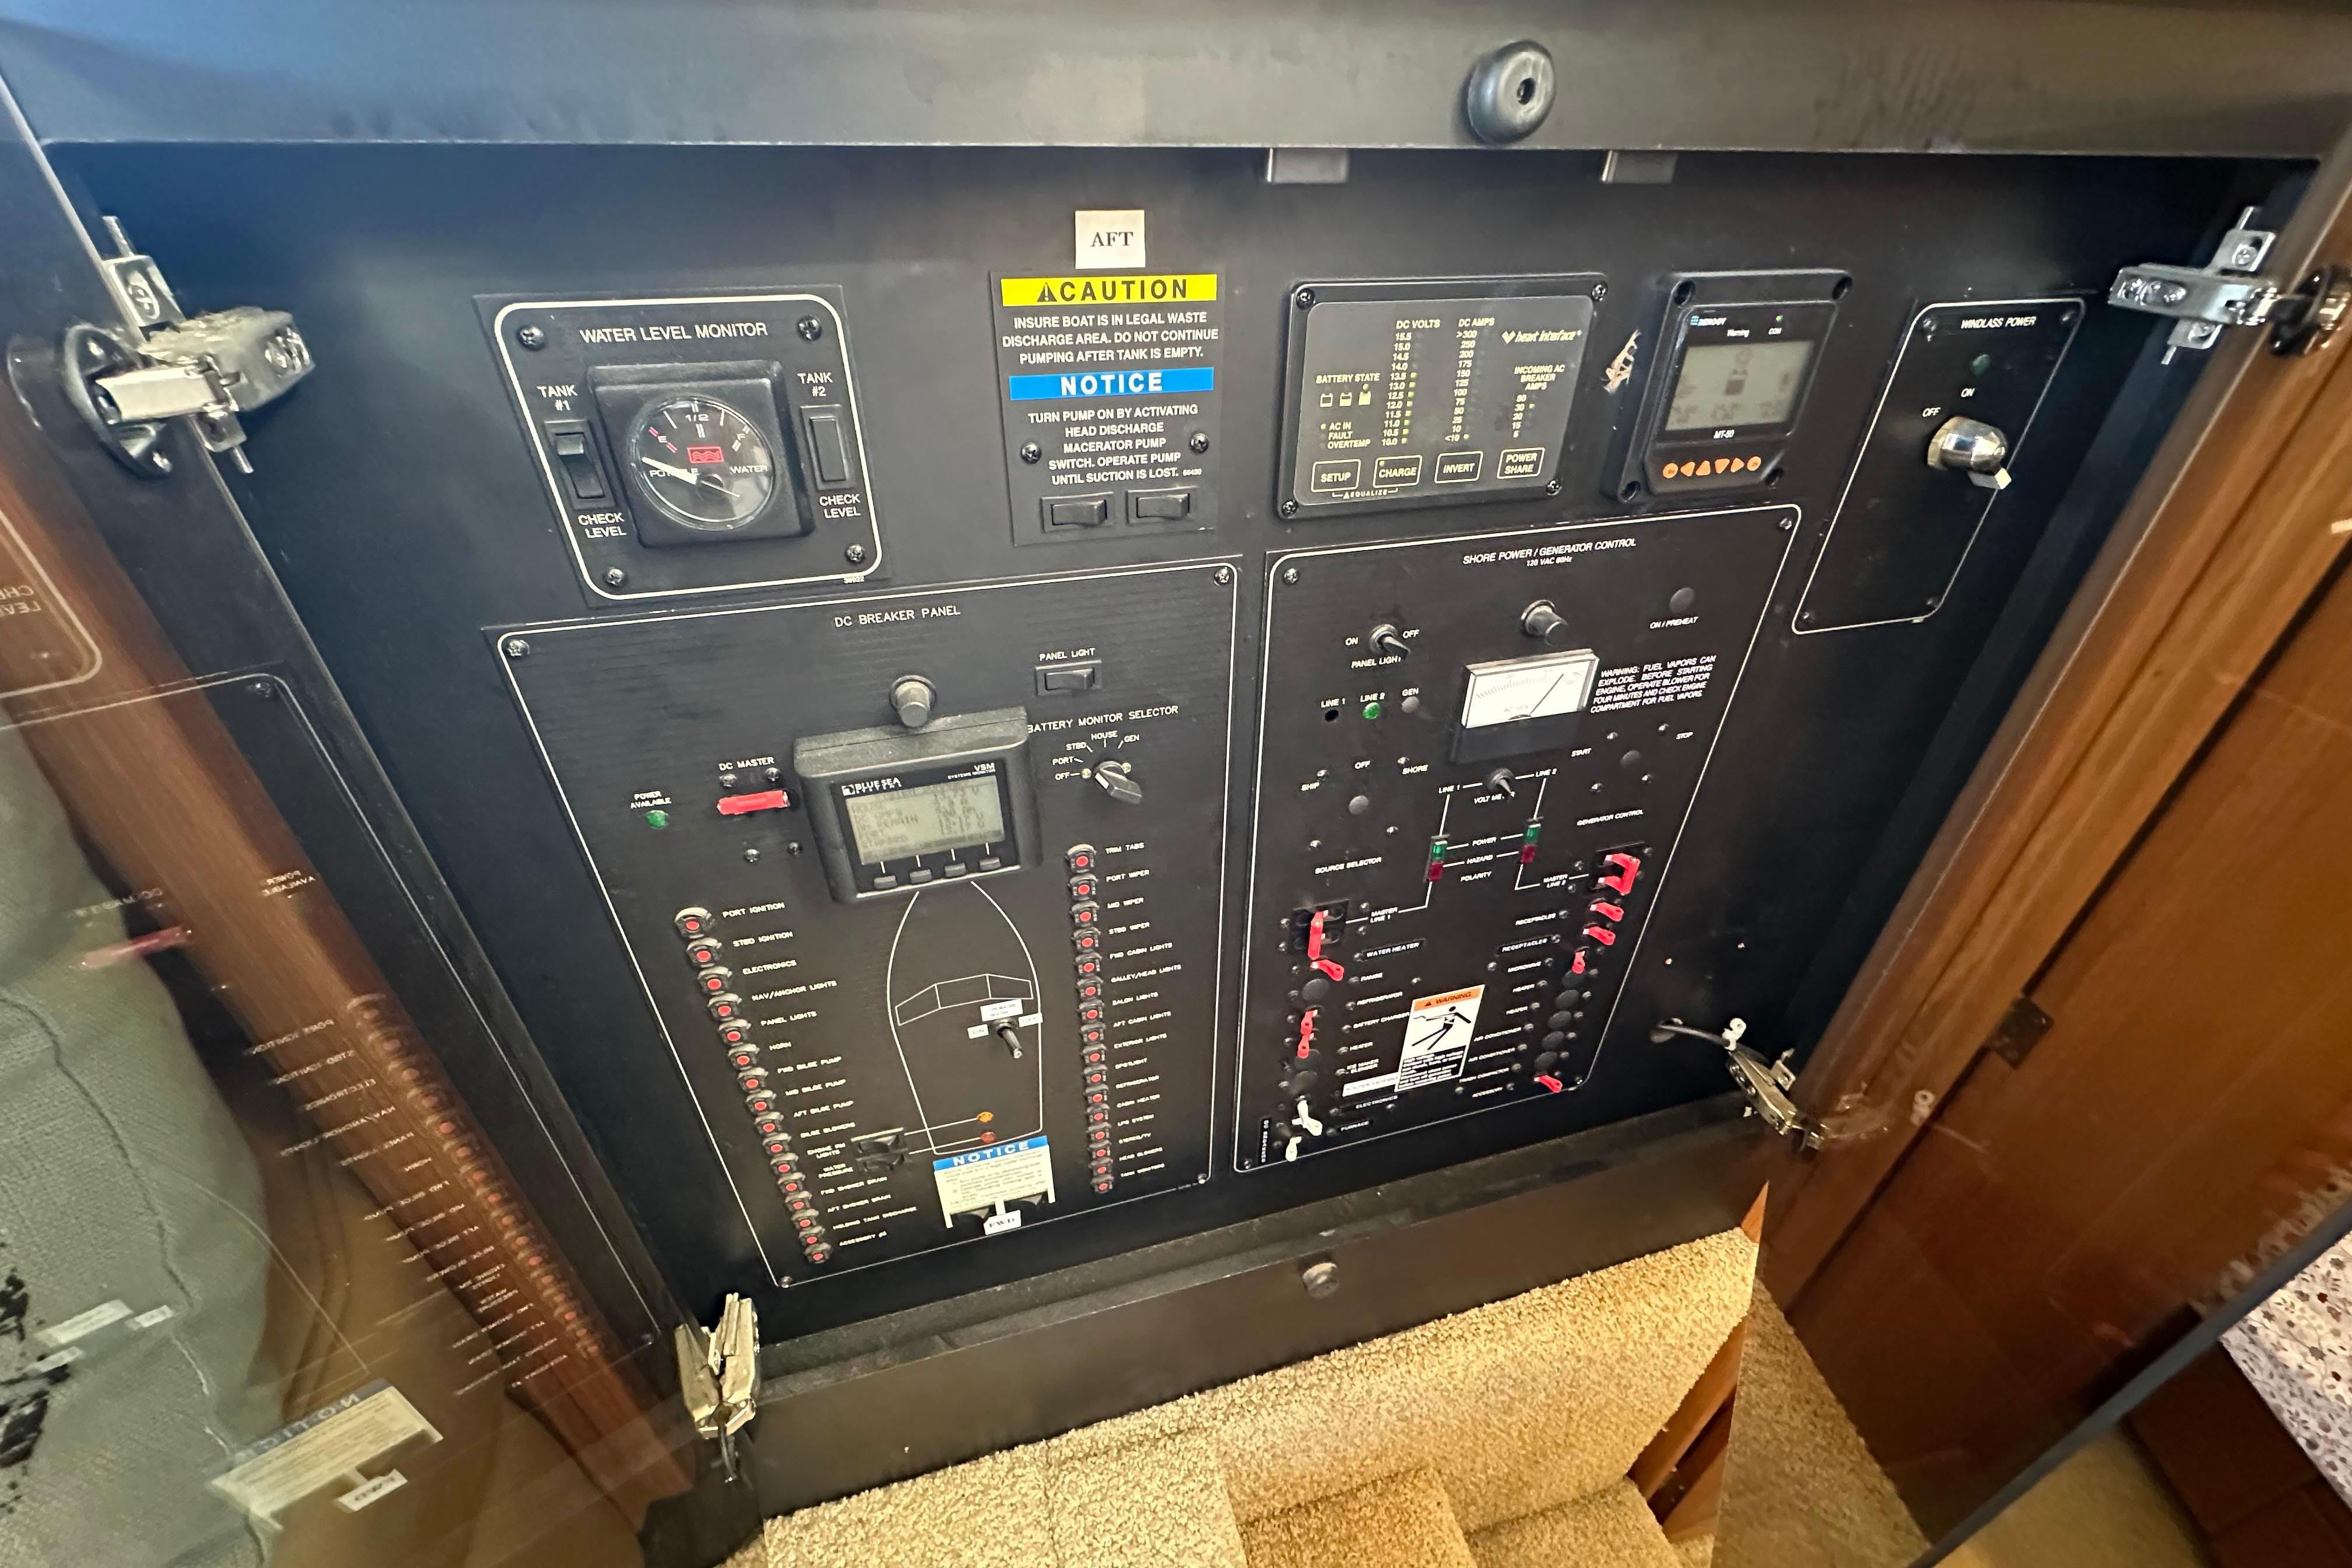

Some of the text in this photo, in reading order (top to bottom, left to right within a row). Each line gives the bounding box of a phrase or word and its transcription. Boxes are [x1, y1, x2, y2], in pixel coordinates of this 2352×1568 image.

[1091, 232, 1133, 247] AFT
[1060, 279, 1186, 302] CAUTION
[1014, 312, 1207, 329] INSURE BOAT IS IN LEGAL WASTE
[1396, 319, 1440, 329] DC VOLTS
[1458, 317, 1495, 327] DC AMPS
[1961, 316, 2036, 329] WINDLASS POWER
[579, 323, 768, 343] WATER LEVEL MONITOR
[1002, 328, 1219, 347] DISCHARGE AREA. DO NOT CONTINUE
[1395, 332, 1412, 341] 15.5
[1514, 330, 1576, 342] heart interface
[1394, 342, 1410, 351] 15.0
[1020, 346, 1203, 365] PUMPING AFTER TANK IS EMPTY.
[1392, 352, 1409, 360] 14.5
[1391, 362, 1408, 371] 14.0
[1514, 364, 1565, 374] INCOMING AC
[797, 372, 833, 384] TANK
[1316, 373, 1380, 384] BATTERY STATE
[1390, 372, 1406, 380] 13.5
[1520, 373, 1556, 383] BREAKER
[1061, 372, 1162, 396] NOTICE
[1389, 382, 1405, 390] 13.0
[1525, 382, 1547, 390] AMPS
[537, 384, 578, 398] TANK
[812, 386, 827, 397] #2
[1388, 391, 1404, 400] 12.5
[1961, 388, 1975, 397] ON
[555, 400, 570, 411] #1
[1387, 401, 1403, 409] 12.0
[1028, 404, 1198, 424] TURN PUMP ON BY ACTIVATING
[1385, 410, 1401, 418] 11.5
[1922, 407, 1941, 417] OFF
[1329, 421, 1352, 430] AC IN
[1384, 419, 1400, 428] 11.0
[1065, 422, 1164, 438] HEAD DISCHARGE
[1383, 429, 1399, 437] 10.5
[737, 433, 746, 442] F
[1328, 431, 1353, 440] FAULT
[1063, 438, 1166, 453] MACERATOR PUMP
[1328, 439, 1371, 449] OVERTEMP
[1381, 438, 1398, 446] 10.0
[1049, 452, 1181, 470] SWITCH. OPERATE PUMP
[1506, 453, 1537, 463] POWER
[730, 463, 768, 474] WATER
[1379, 467, 1417, 478] CHARGE
[1443, 463, 1475, 473] INVERT
[1504, 464, 1534, 474] SHARE
[1052, 467, 1179, 485] UNTIL SUCTION IS LOST.
[1321, 472, 1351, 482] SETUP
[820, 494, 860, 506] CHECK
[824, 506, 861, 519] LEVEL
[578, 512, 625, 525] CHECK
[584, 526, 627, 538] LEVEL
[1462, 553, 1496, 564] SHORE
[1498, 549, 1532, 561] POWER
[1539, 542, 1593, 556] GENERATOR
[1594, 538, 1636, 550] CONTROL
[835, 606, 961, 627] DC BREAKER PANEL
[1402, 629, 1420, 638] OFF
[1345, 637, 1358, 646] ON
[1040, 648, 1095, 661] PANEL LIGHT
[1351, 659, 1377, 668] PANEL
[1601, 655, 1716, 678] WARNING: FUEL VAPORS CAN
[1402, 688, 1419, 696] GEN
[1360, 693, 1378, 702] LINE
[1321, 699, 1339, 708] LINE
[1027, 705, 1178, 733] BATTERY MONITOR SELECTOR
[1091, 730, 1118, 740] HOUSE
[1066, 742, 1086, 750] STBD
[1572, 748, 1591, 757] START
[719, 757, 774, 771] DC MASTER
[1052, 756, 1073, 765] PORT
[1354, 761, 1370, 769] OFF
[974, 762, 995, 772] VSM
[1402, 765, 1429, 775] SHORE
[1055, 772, 1070, 780] OFF
[1301, 782, 1320, 791] SHIP
[1438, 785, 1454, 793] LINE
[634, 791, 662, 800] POWER
[631, 797, 671, 809] AVAILABLE
[1577, 810, 1643, 825] GENERATOR CONTROL
[1472, 836, 1497, 846] POWER
[1125, 842, 1144, 851] TABS
[1466, 855, 1493, 864] HAZARD
[1315, 857, 1381, 874] SOURCE SELECTOR
[1106, 870, 1149, 882] PORT WIPER
[1460, 872, 1492, 881] POLARITY
[722, 902, 785, 918] PORT IGNITION
[1367, 943, 1419, 957] WATER HEATER
[1436, 992, 1471, 1004] WARNING
[761, 1011, 817, 1026] PANEL LIGHTS
[953, 1141, 1030, 1166] NOTICE
